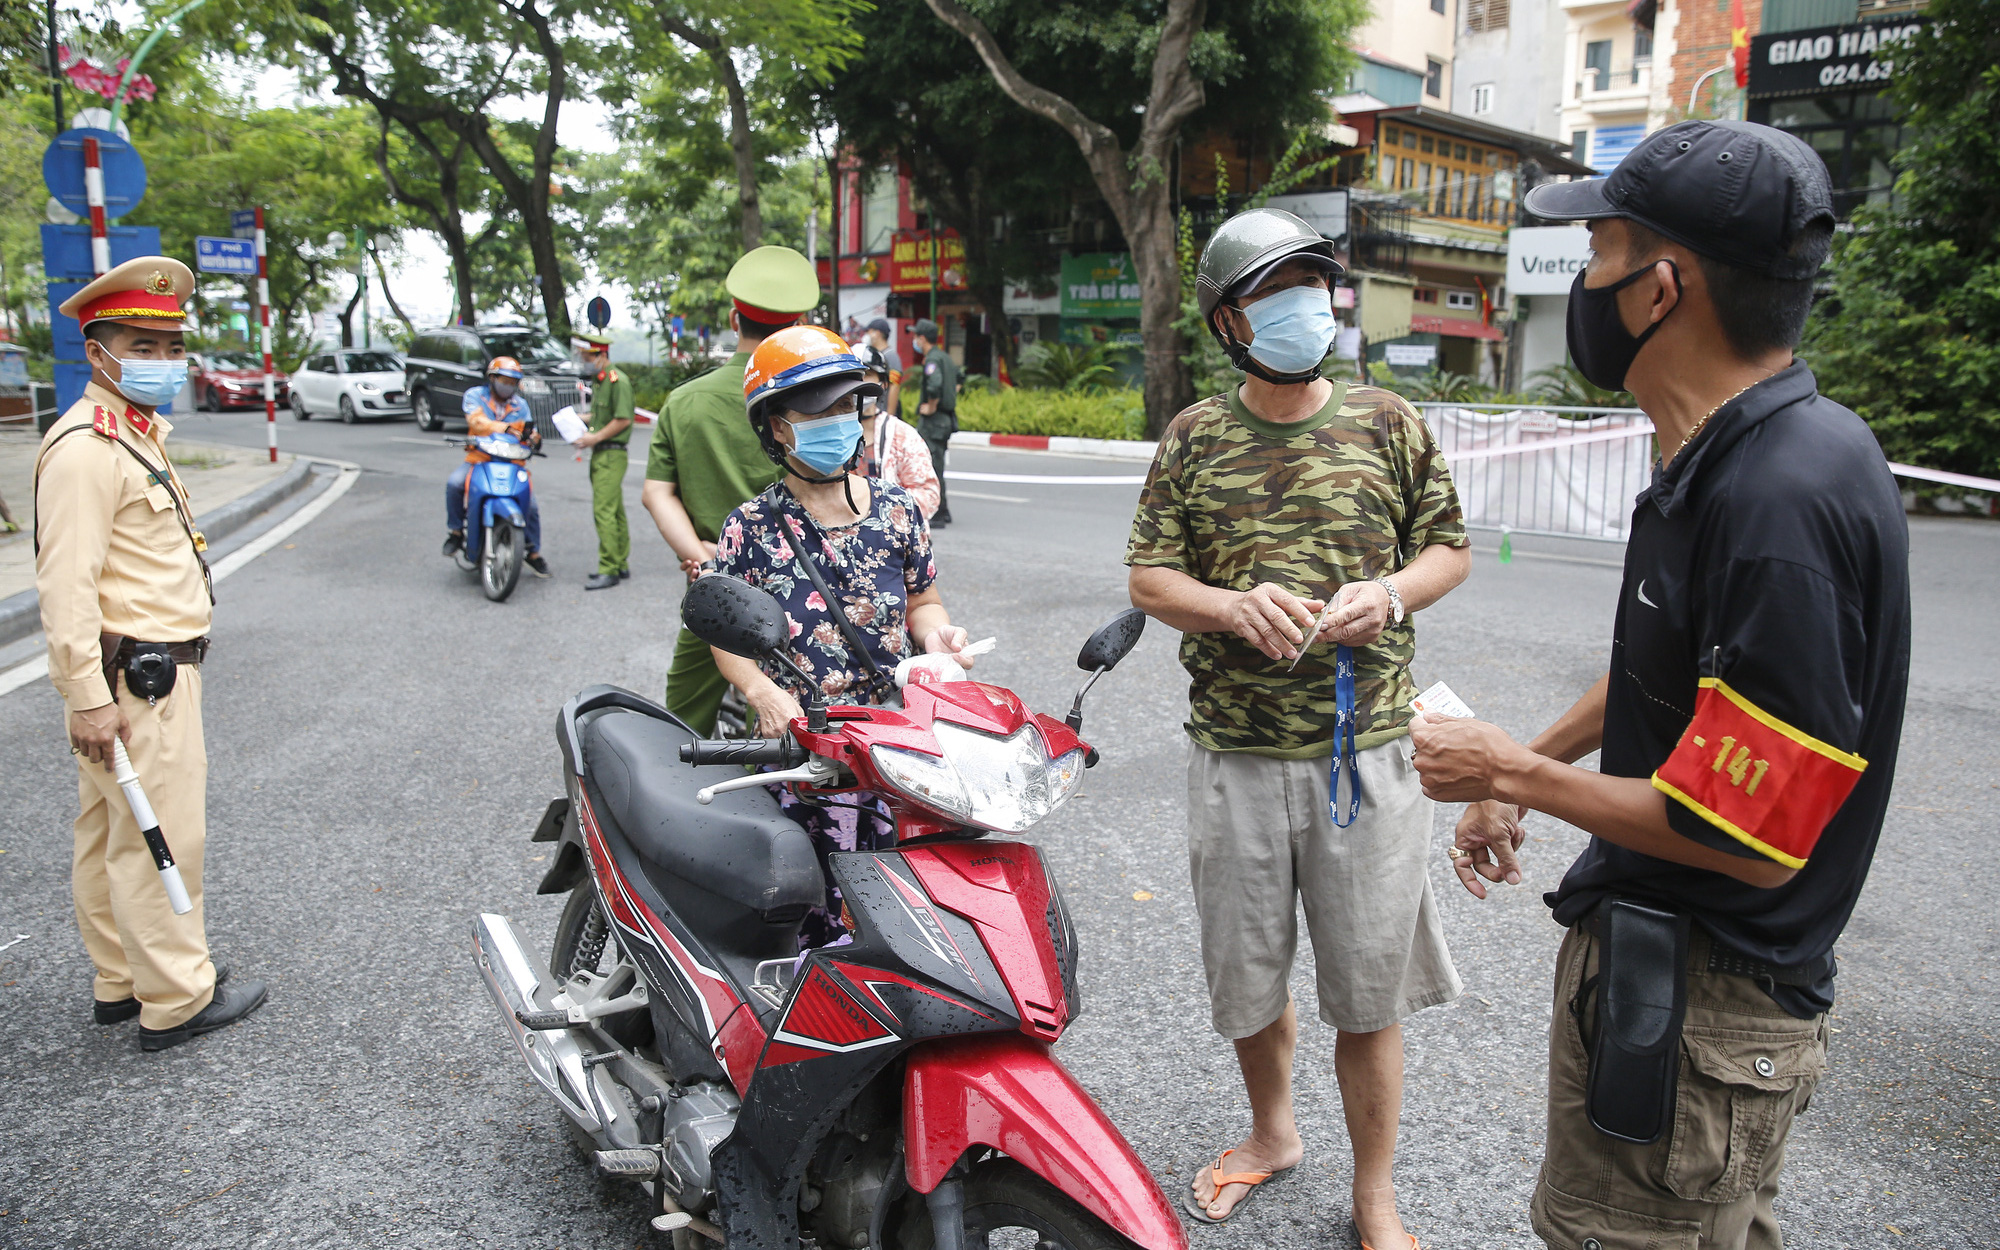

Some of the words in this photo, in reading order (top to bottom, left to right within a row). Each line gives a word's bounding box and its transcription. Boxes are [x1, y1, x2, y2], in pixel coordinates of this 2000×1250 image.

[1768, 35, 1833, 66] GIAO
[1819, 59, 1894, 87] 024.63
[1712, 735, 1770, 797] 141
[969, 856, 1017, 867] HONDA
[814, 972, 870, 1034] HONDA
